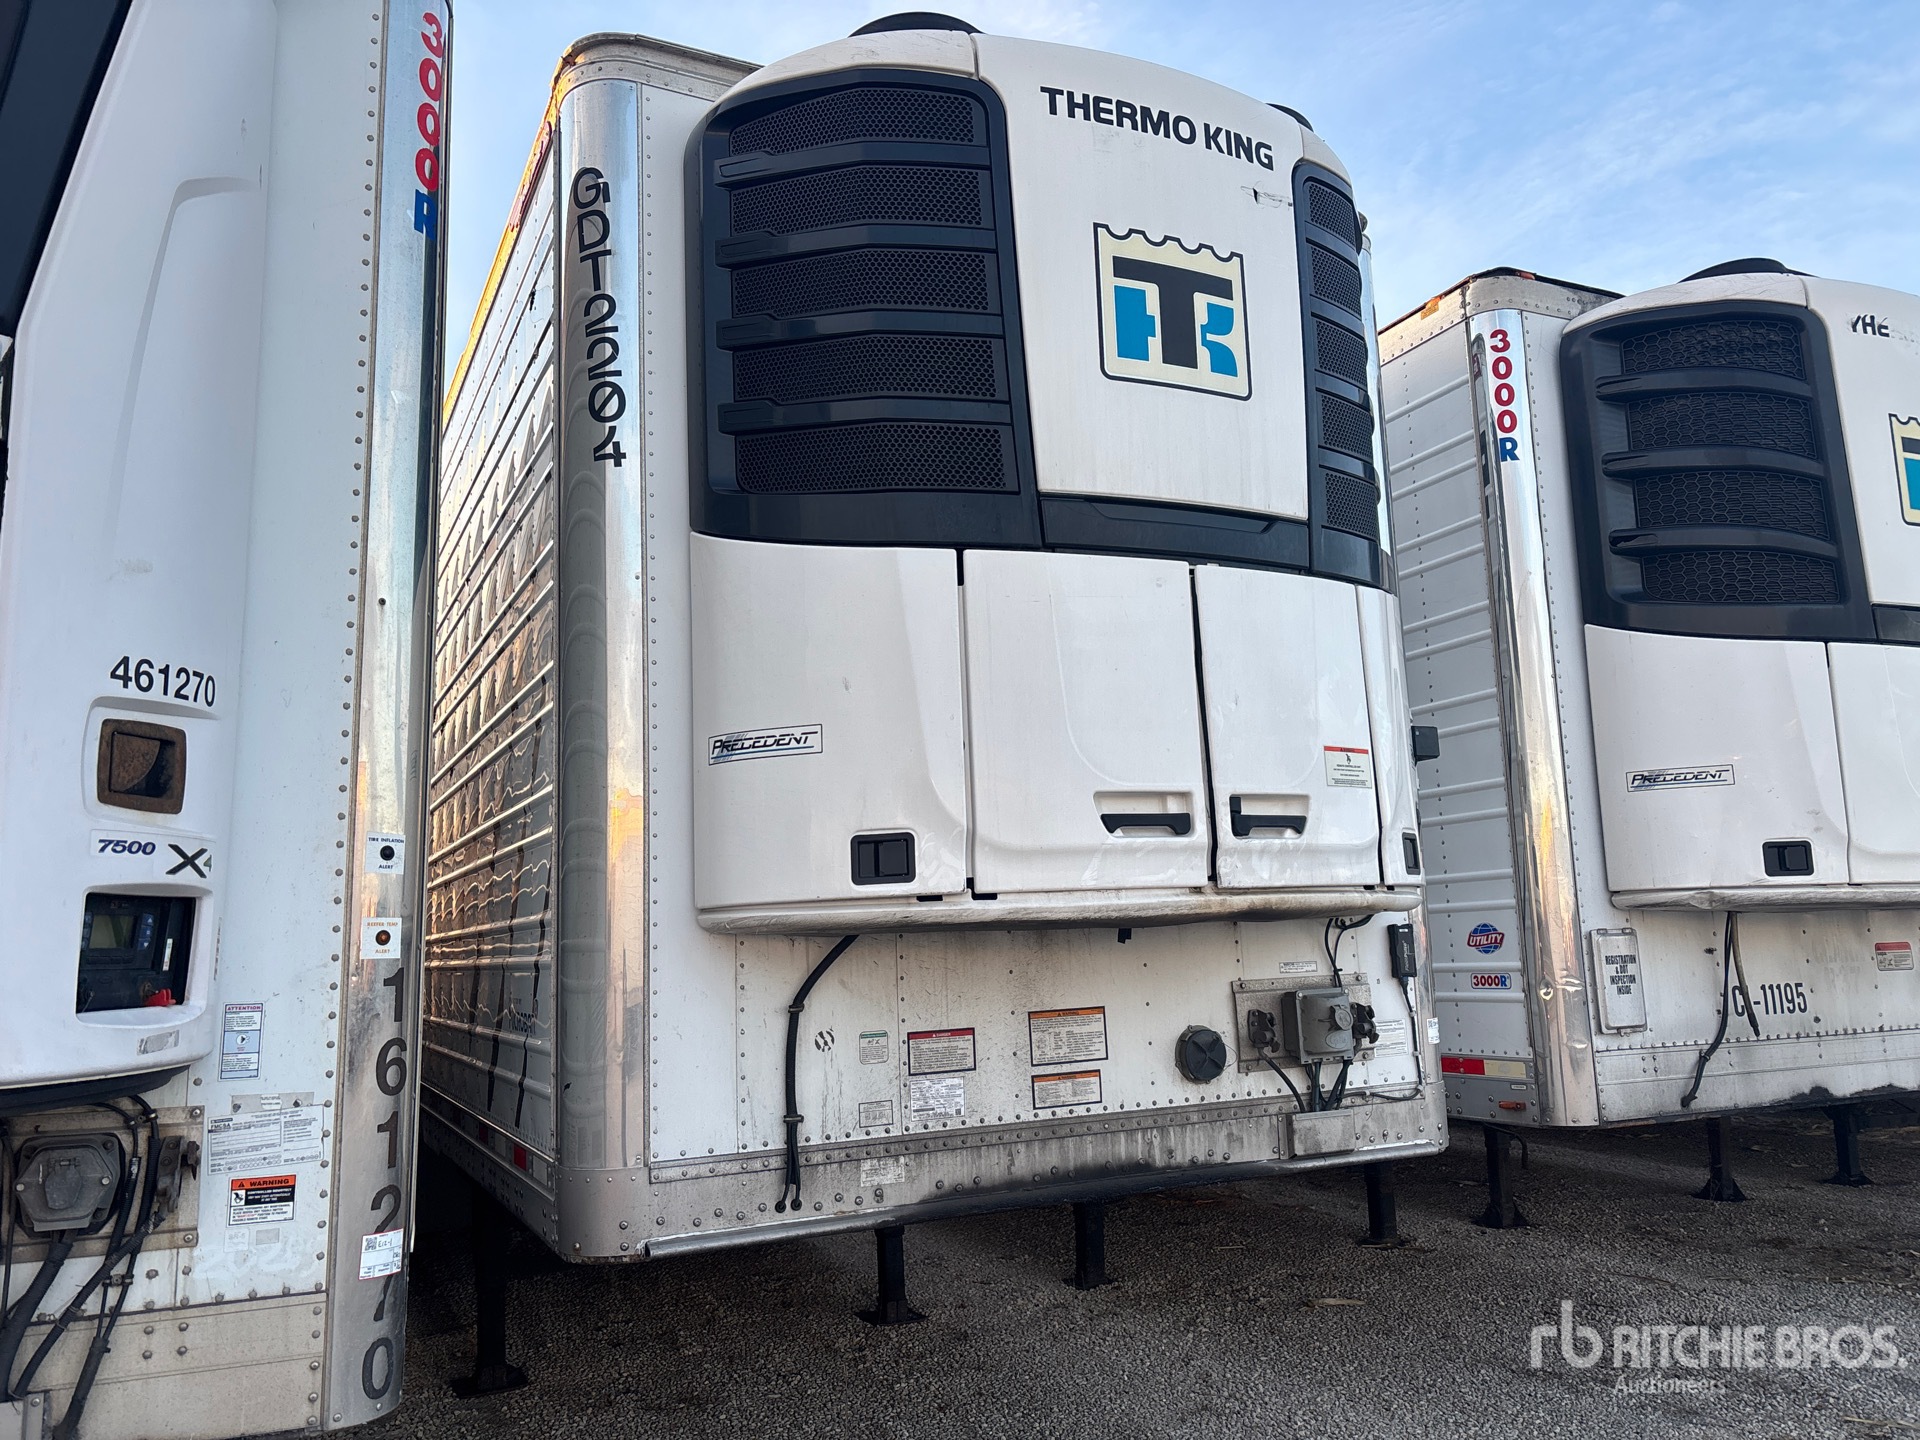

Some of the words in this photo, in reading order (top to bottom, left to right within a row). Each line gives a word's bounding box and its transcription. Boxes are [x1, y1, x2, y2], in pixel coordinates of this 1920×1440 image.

[414, 12, 443, 241] 3000R
[1040, 86, 1197, 145] THERMO
[1203, 122, 1274, 171] KING
[1490, 329, 1520, 462] 3000R
[110, 656, 216, 707] 461270
[711, 731, 819, 755] PRECEDENT
[1631, 769, 1730, 785] PRECEDENT
[98, 839, 156, 855] 7500
[1469, 934, 1503, 946] UTILITY
[1605, 955, 1636, 965] REGISTRATION
[1473, 975, 1508, 987] 3000R
[1610, 975, 1636, 985] INSPECTION
[1616, 985, 1632, 995] INSIDE
[249, 1179, 289, 1187] WARNING
